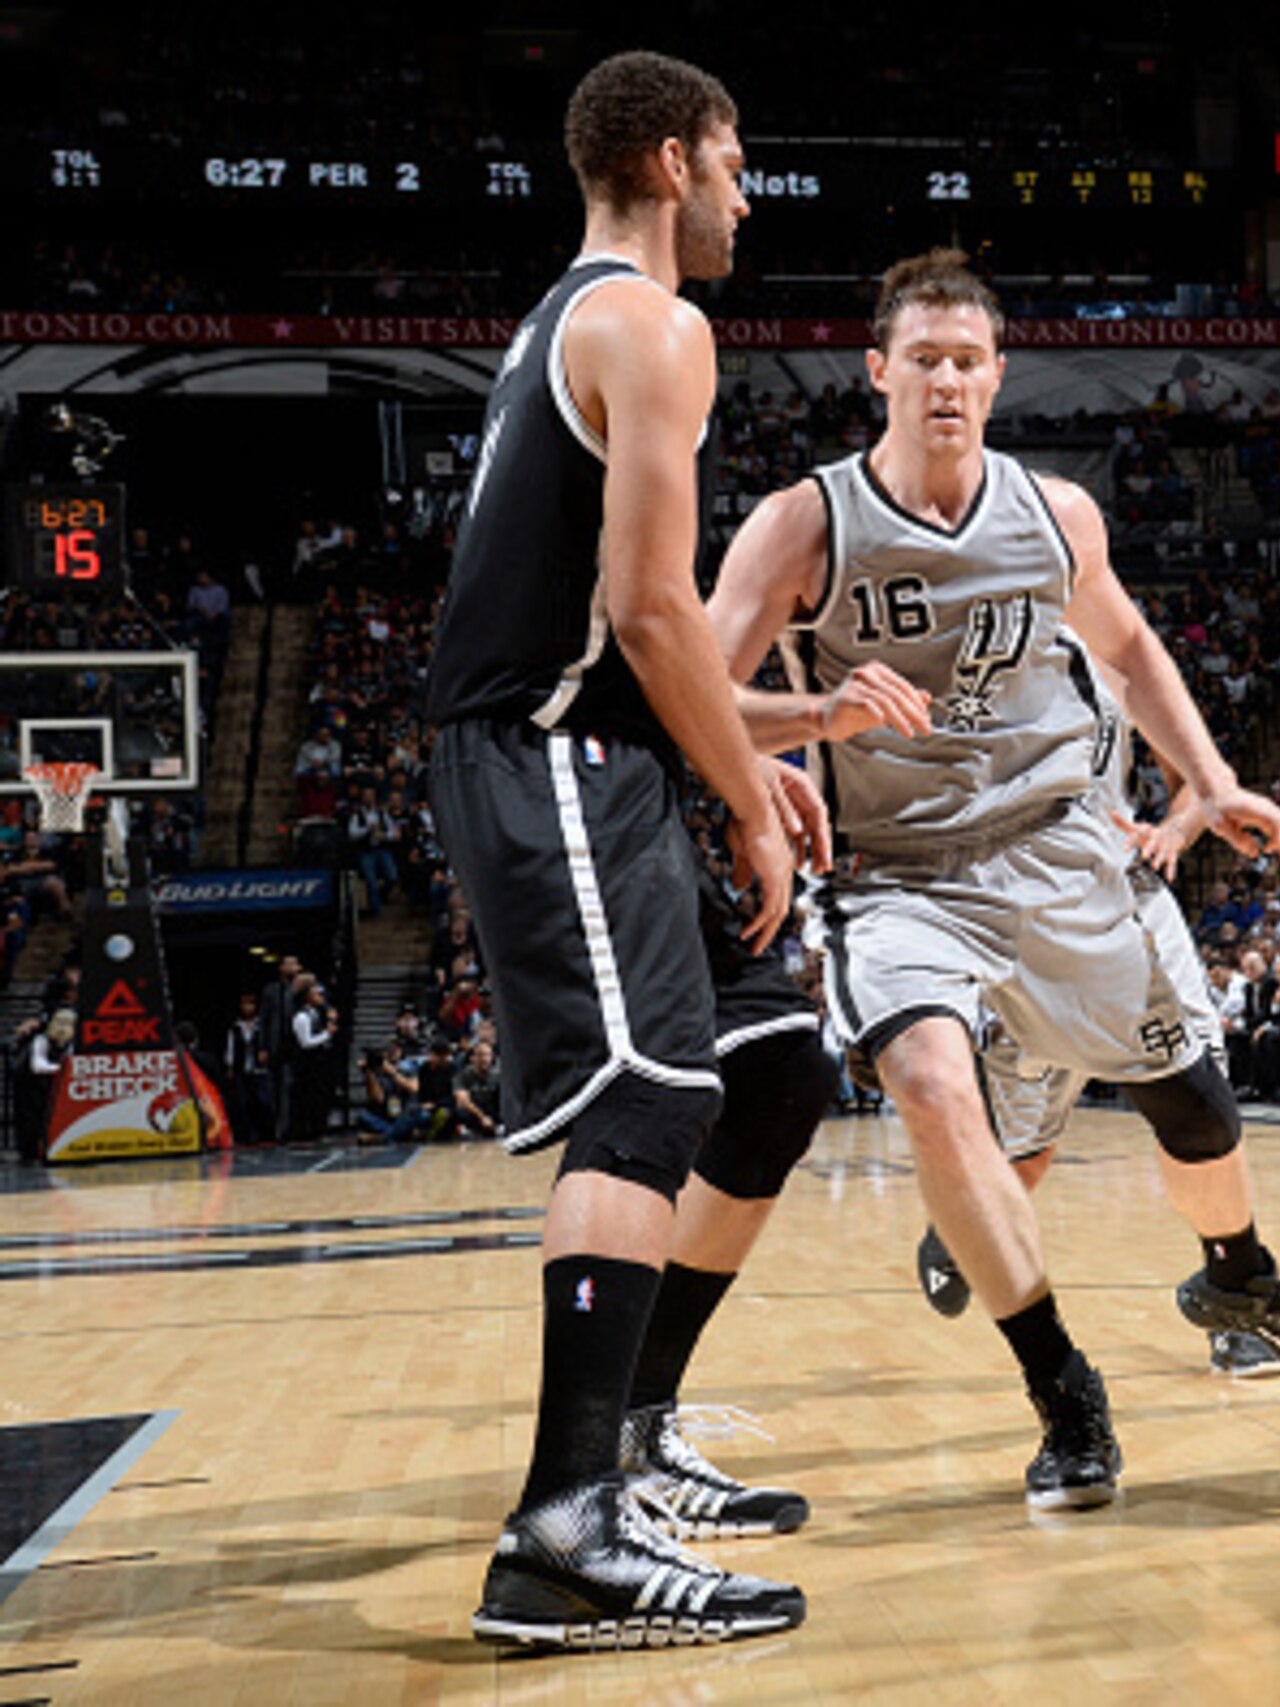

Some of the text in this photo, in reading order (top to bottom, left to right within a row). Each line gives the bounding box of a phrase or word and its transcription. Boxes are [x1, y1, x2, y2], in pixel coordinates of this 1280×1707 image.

[205, 158, 420, 191] 6:27 PER 2
[926, 171, 971, 199] 22
[41, 499, 106, 528] 6:27
[55, 530, 101, 579] 15
[847, 573, 937, 645] 16
[158, 878, 323, 902] BUD LIGHT
[82, 1016, 160, 1046] PEAK
[71, 1051, 178, 1077] BRAKE
[67, 1073, 178, 1101] CHECK
